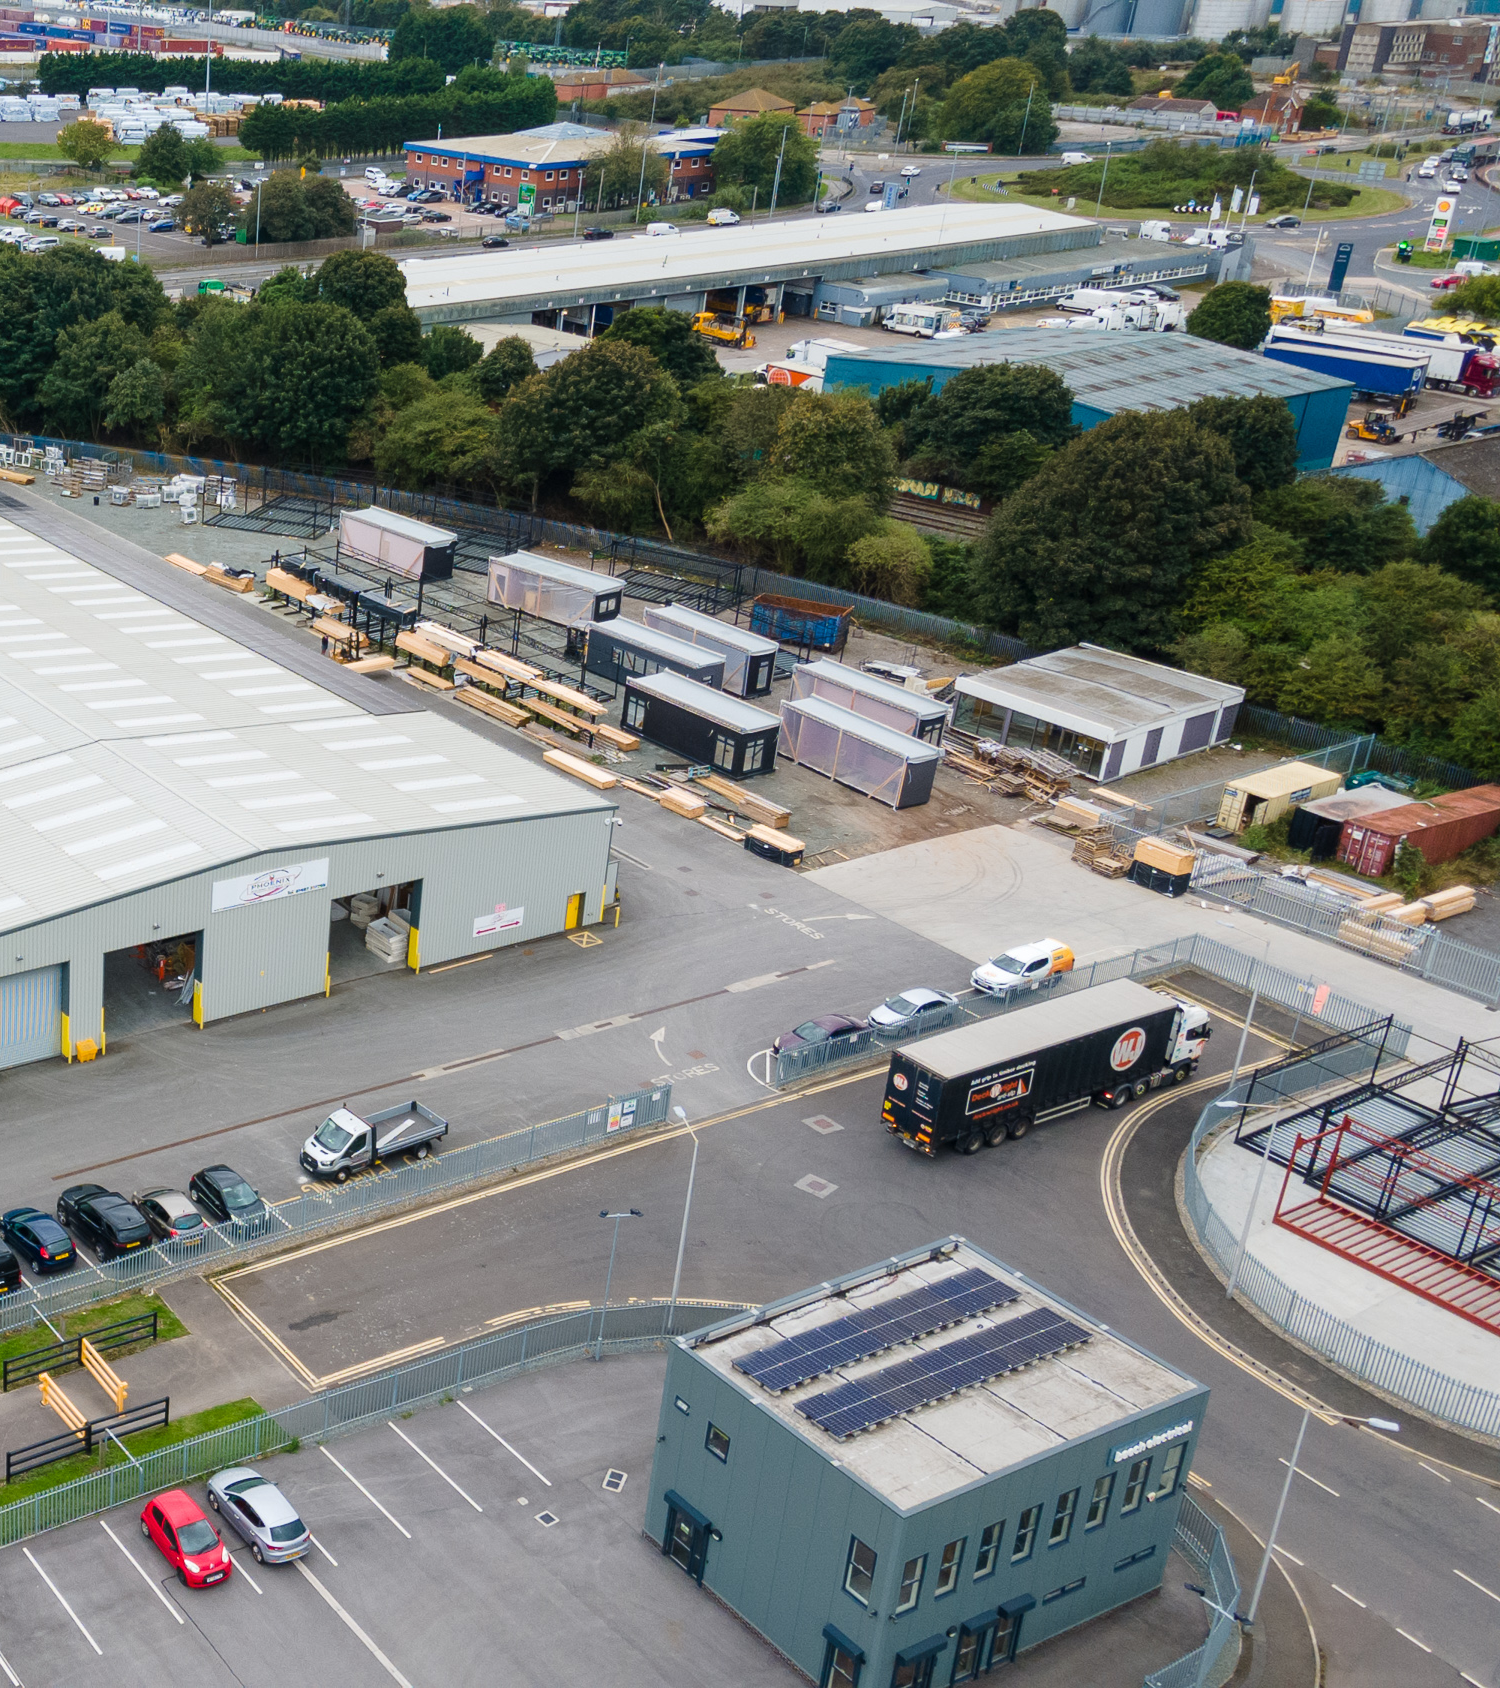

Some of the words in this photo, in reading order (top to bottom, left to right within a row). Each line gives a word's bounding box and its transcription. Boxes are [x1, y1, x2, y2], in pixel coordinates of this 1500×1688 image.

[251, 878, 291, 890] PHOENIX
[763, 907, 825, 940] STORES
[650, 1063, 719, 1086] STORES
[981, 1075, 991, 1083] grip
[999, 1067, 1015, 1076] timber
[1016, 1061, 1036, 1070] decking
[1114, 1441, 1146, 1463] beech
[1146, 1420, 1193, 1449] electrical
